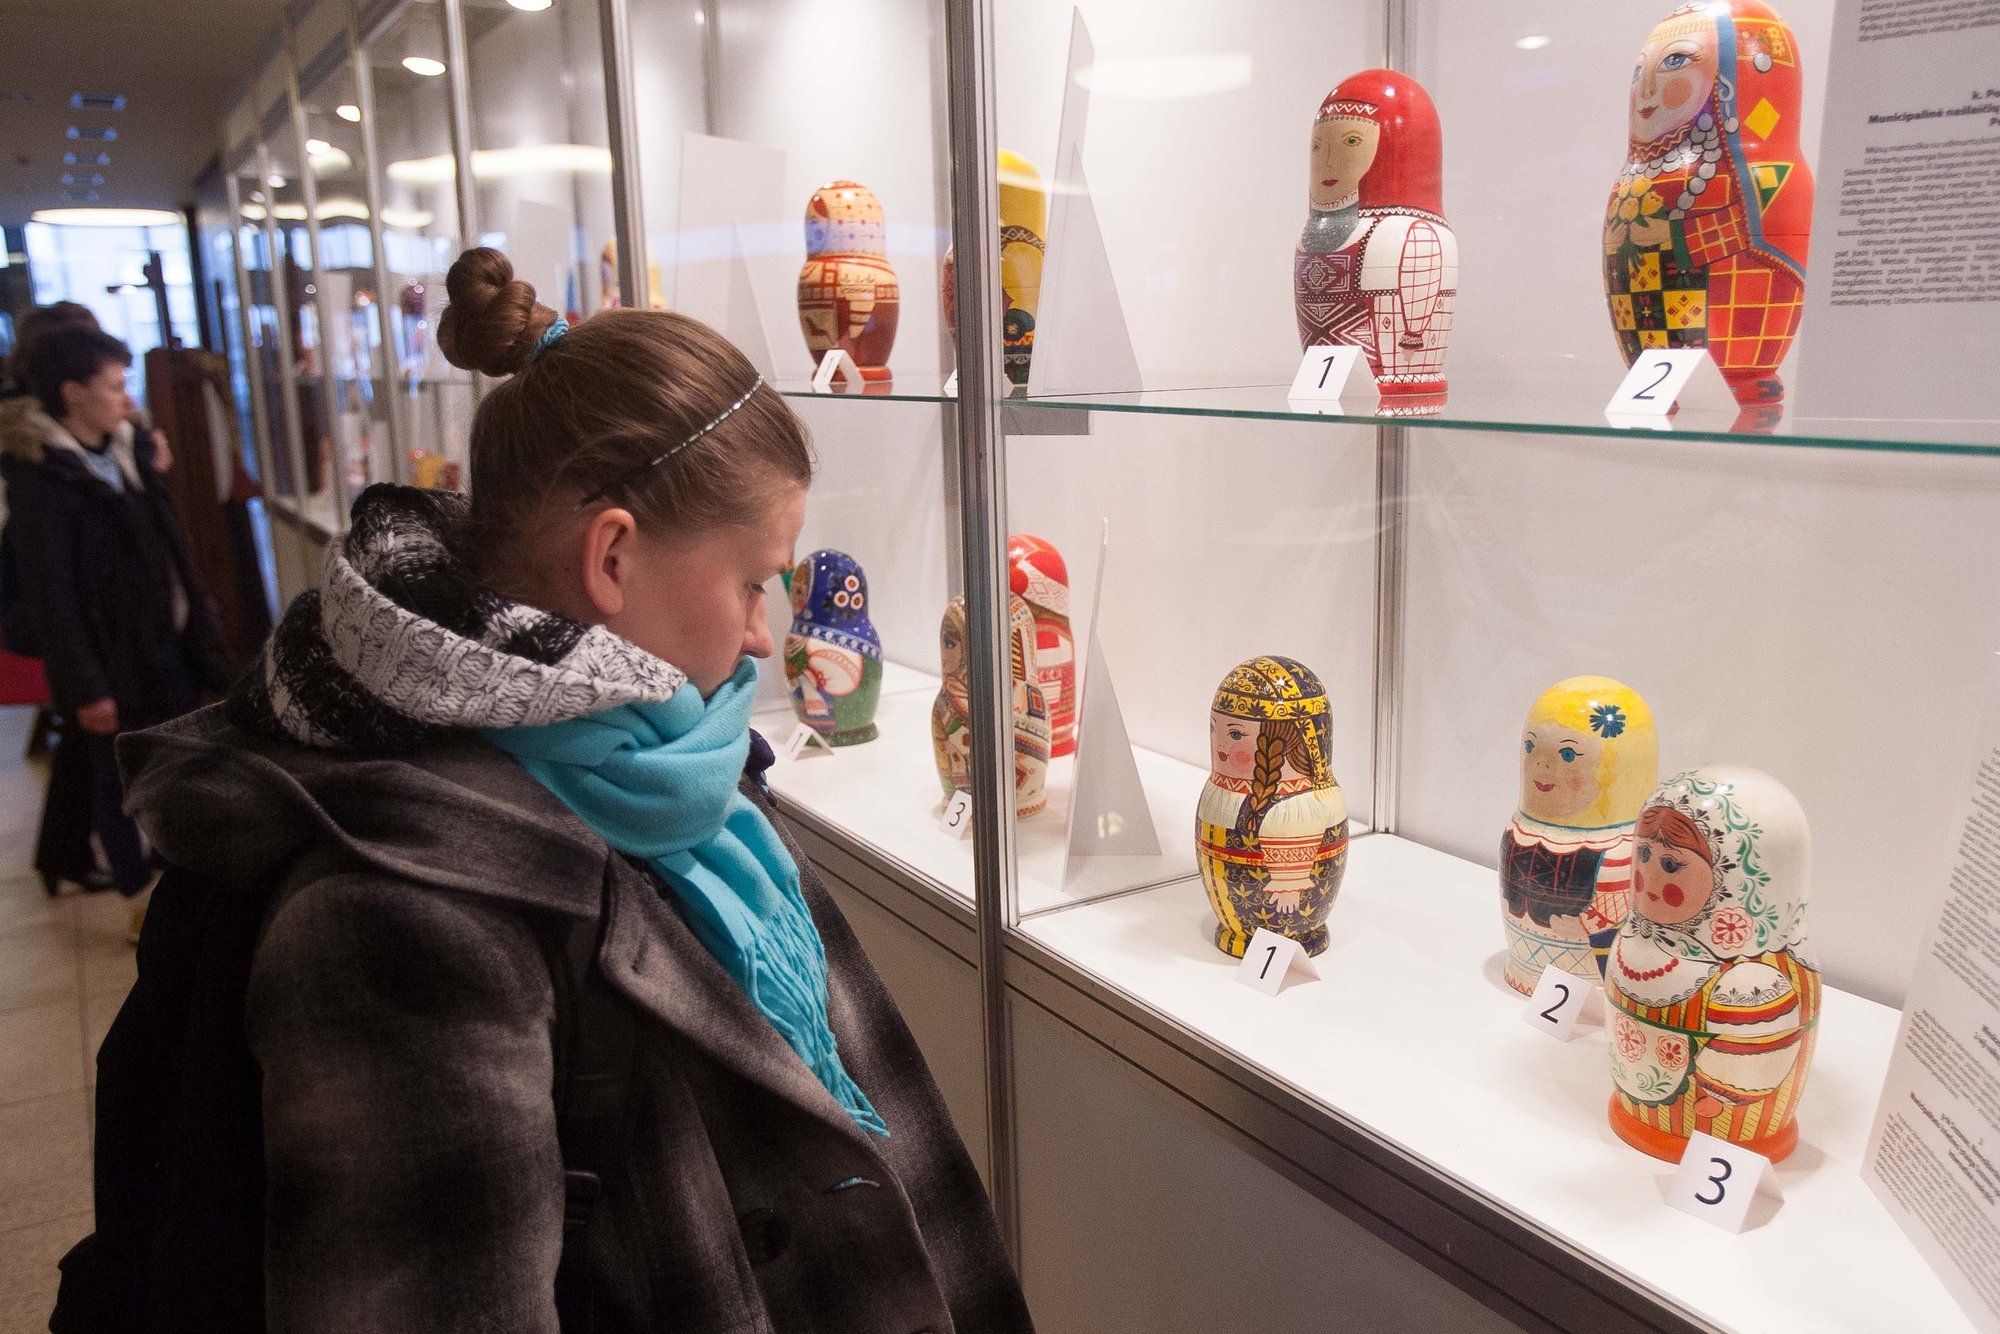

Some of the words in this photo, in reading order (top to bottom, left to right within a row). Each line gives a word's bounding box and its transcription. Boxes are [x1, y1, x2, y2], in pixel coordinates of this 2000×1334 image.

[1317, 355, 1335, 389] 1
[1631, 361, 1673, 400] 2
[948, 802, 966, 827] 3
[1259, 945, 1277, 980] 1
[1540, 983, 1569, 1024] 2
[1694, 1157, 1732, 1205] 3
